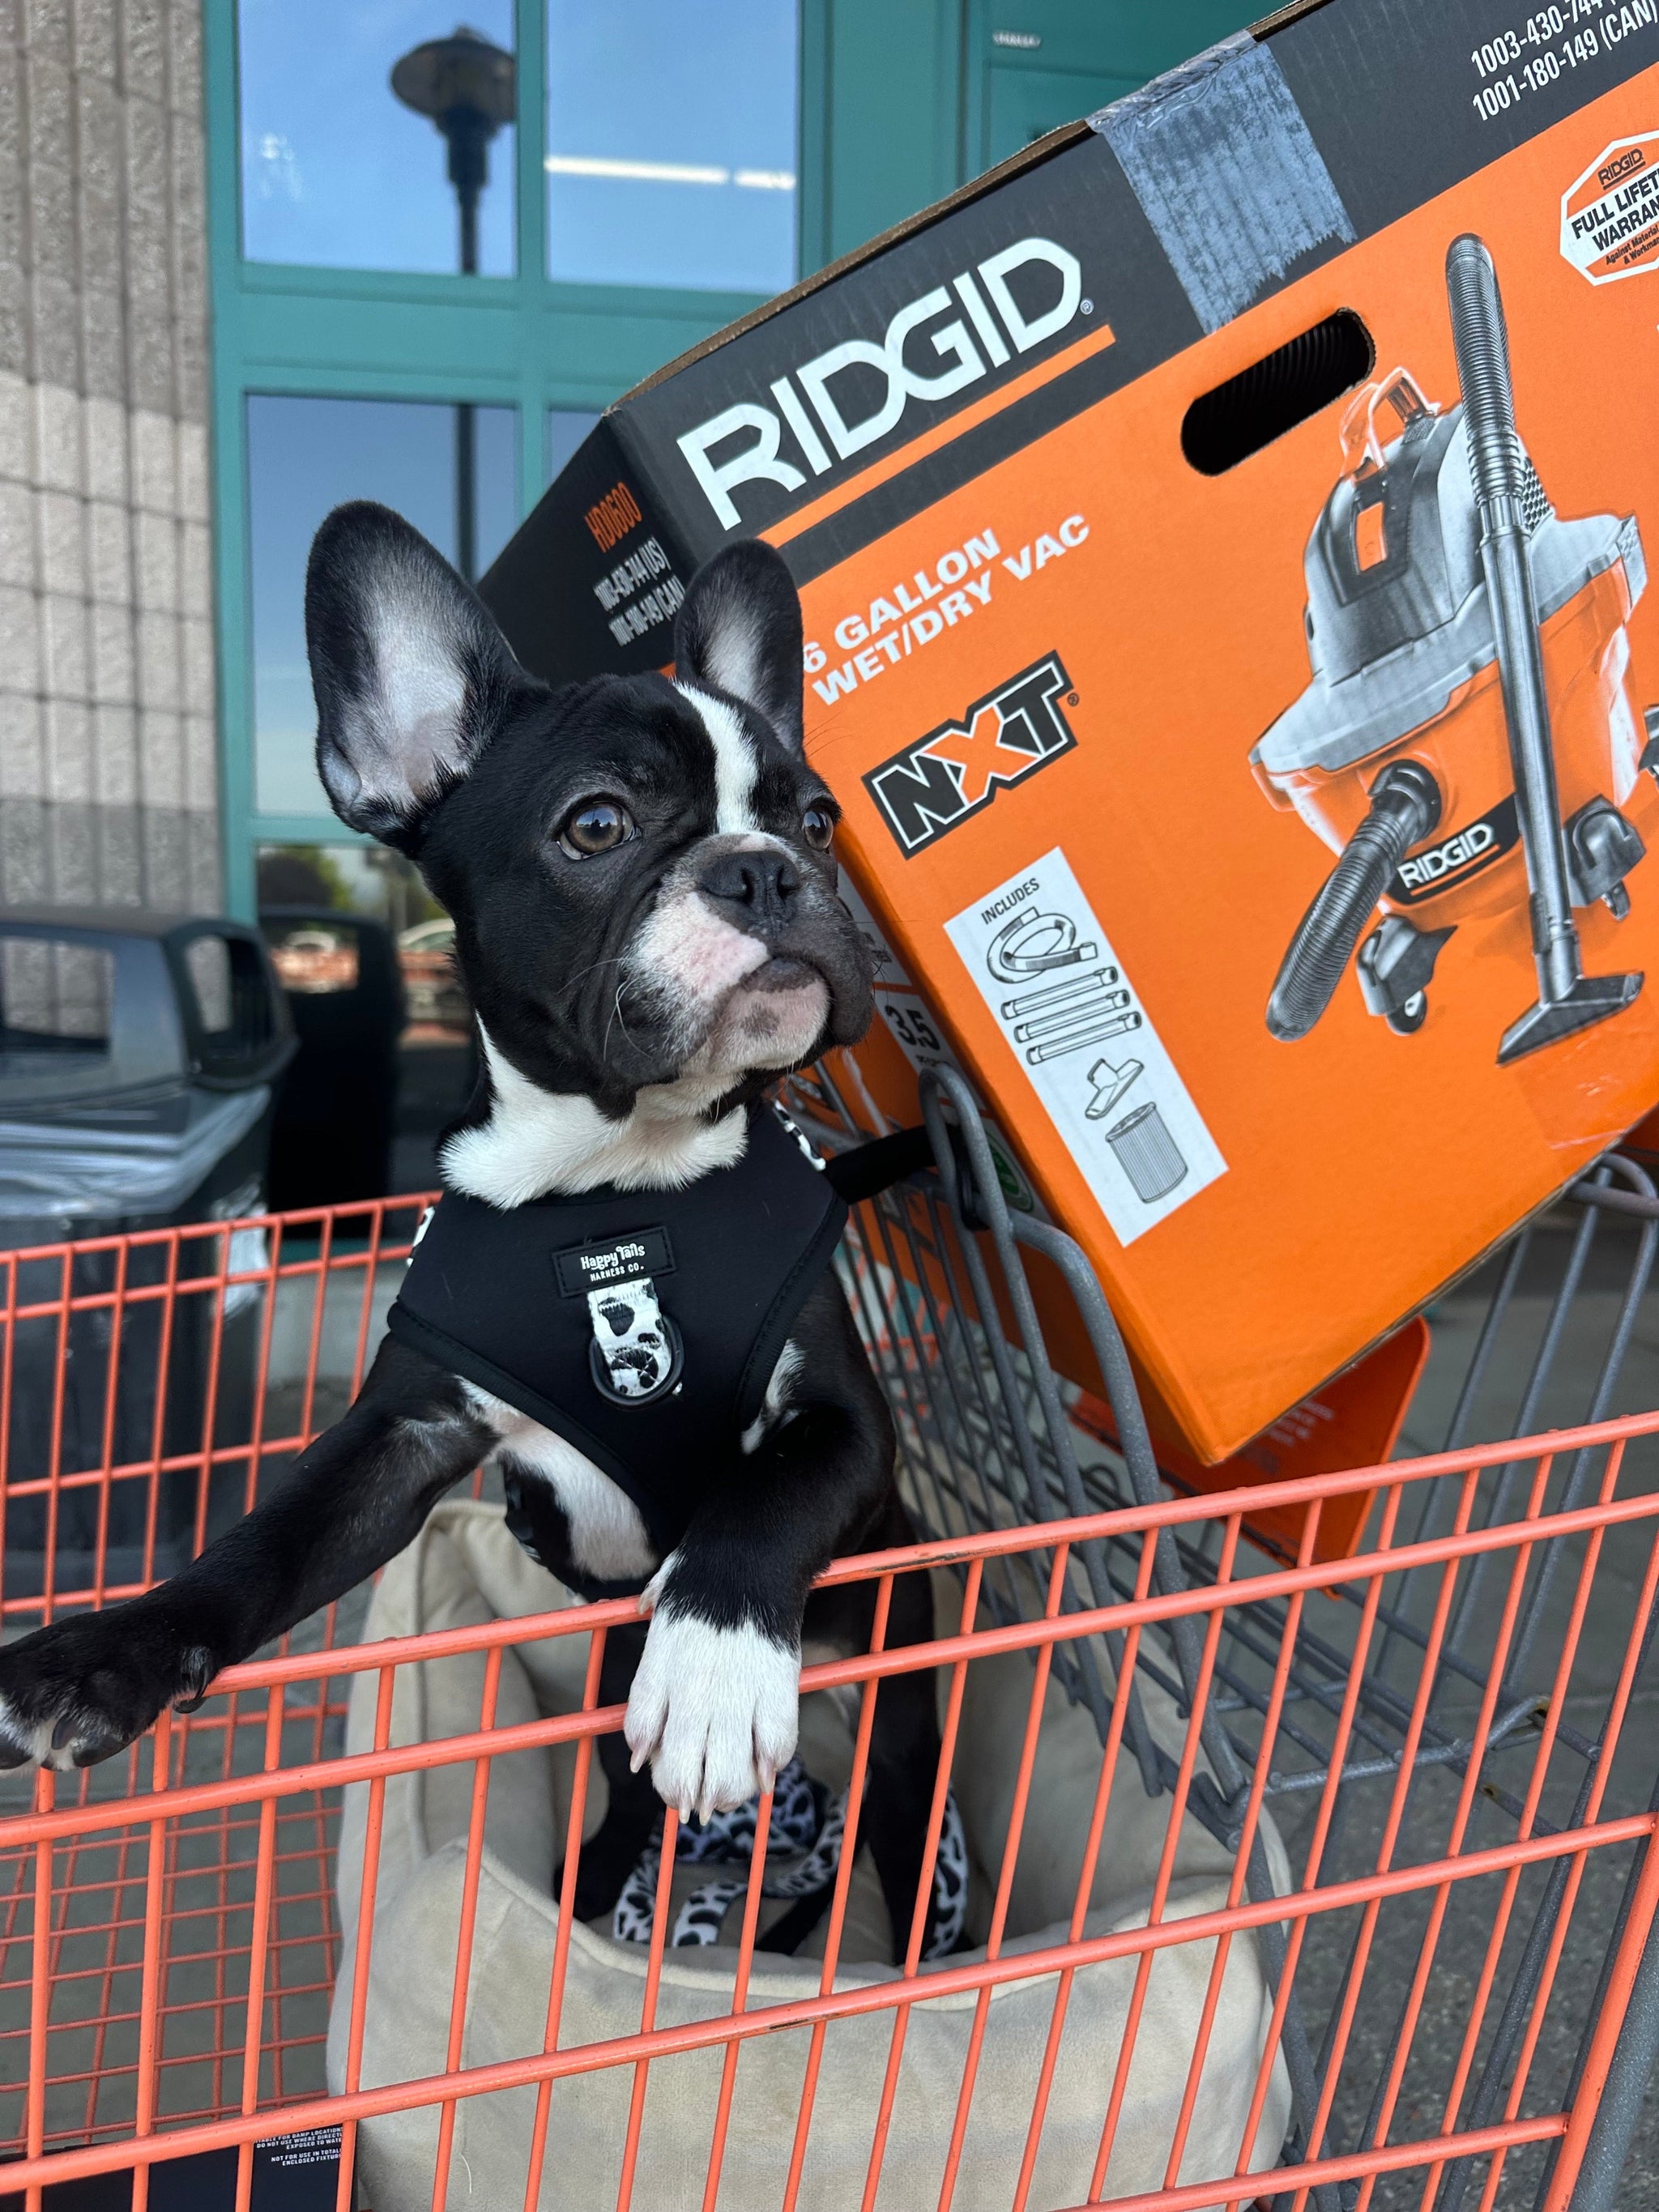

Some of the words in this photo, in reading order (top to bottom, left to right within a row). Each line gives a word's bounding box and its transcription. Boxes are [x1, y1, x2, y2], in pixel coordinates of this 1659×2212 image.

[1472, 28, 1599, 121] 1001-180-149
[1599, 0, 1658, 51] (CAN)
[1597, 148, 1644, 185] RIDGID
[1572, 202, 1614, 239] FULL
[1614, 168, 1659, 212] LIFET
[1606, 242, 1631, 265] Against
[676, 237, 1082, 531] RIDGID
[584, 481, 642, 553] HD0600
[804, 641, 827, 674] 6
[834, 527, 1001, 650] GALLON
[812, 570, 992, 705] WET/DRY
[1002, 513, 1090, 581] VAC
[871, 660, 1065, 850] NXT
[1397, 822, 1495, 889] RIDGID
[980, 877, 1040, 925] INCLUDES
[580, 1252, 619, 1270] Happy
[616, 1242, 646, 1260] Tails
[590, 1265, 625, 1282] HARNESS
[628, 1262, 645, 1272] CO.
[286, 2142, 315, 2150] EXPOSED
[292, 2131, 310, 2139] DAMP
[294, 2136, 316, 2144] WHERE
[282, 2158, 315, 2167] ENCLOSED
